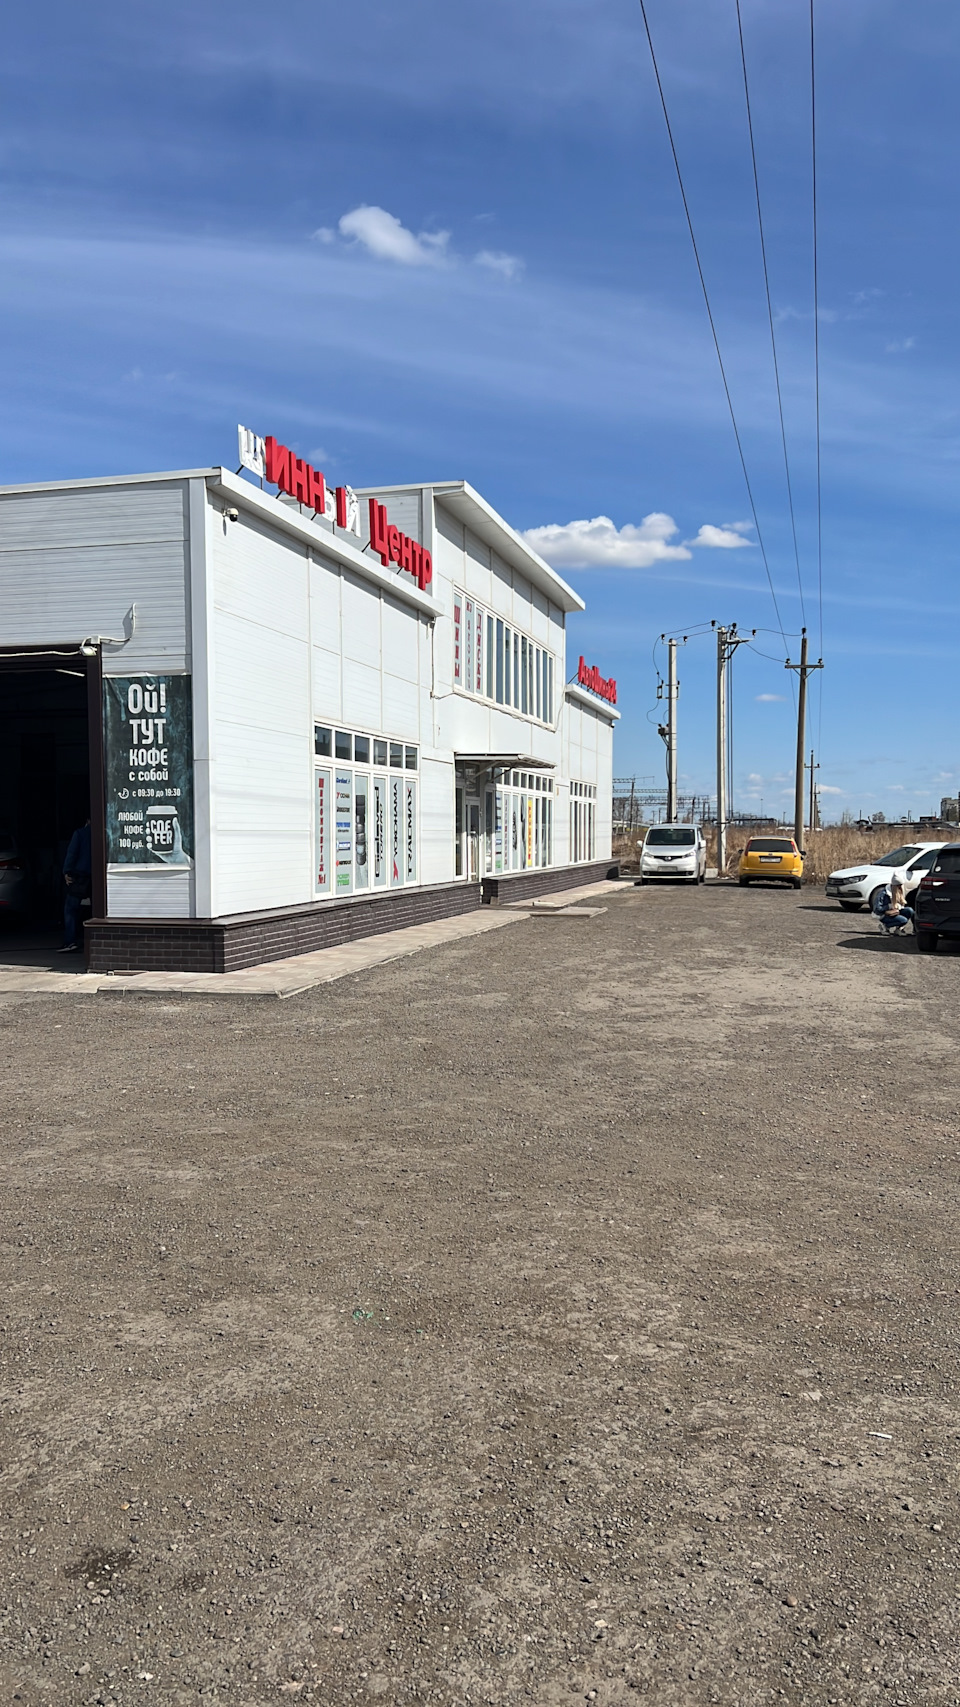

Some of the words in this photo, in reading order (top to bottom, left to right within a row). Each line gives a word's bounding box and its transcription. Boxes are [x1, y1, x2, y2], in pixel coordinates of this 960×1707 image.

[368, 498, 433, 591] Центр
[129, 748, 168, 767] КОФЕ
[138, 768, 169, 782] собой
[137, 788, 155, 797] 09:30
[155, 790, 164, 798] до
[165, 788, 181, 797] 19:30
[117, 810, 144, 821] ЛЮБОЙ
[124, 824, 144, 835] КОФЕ
[119, 838, 131, 848] 100
